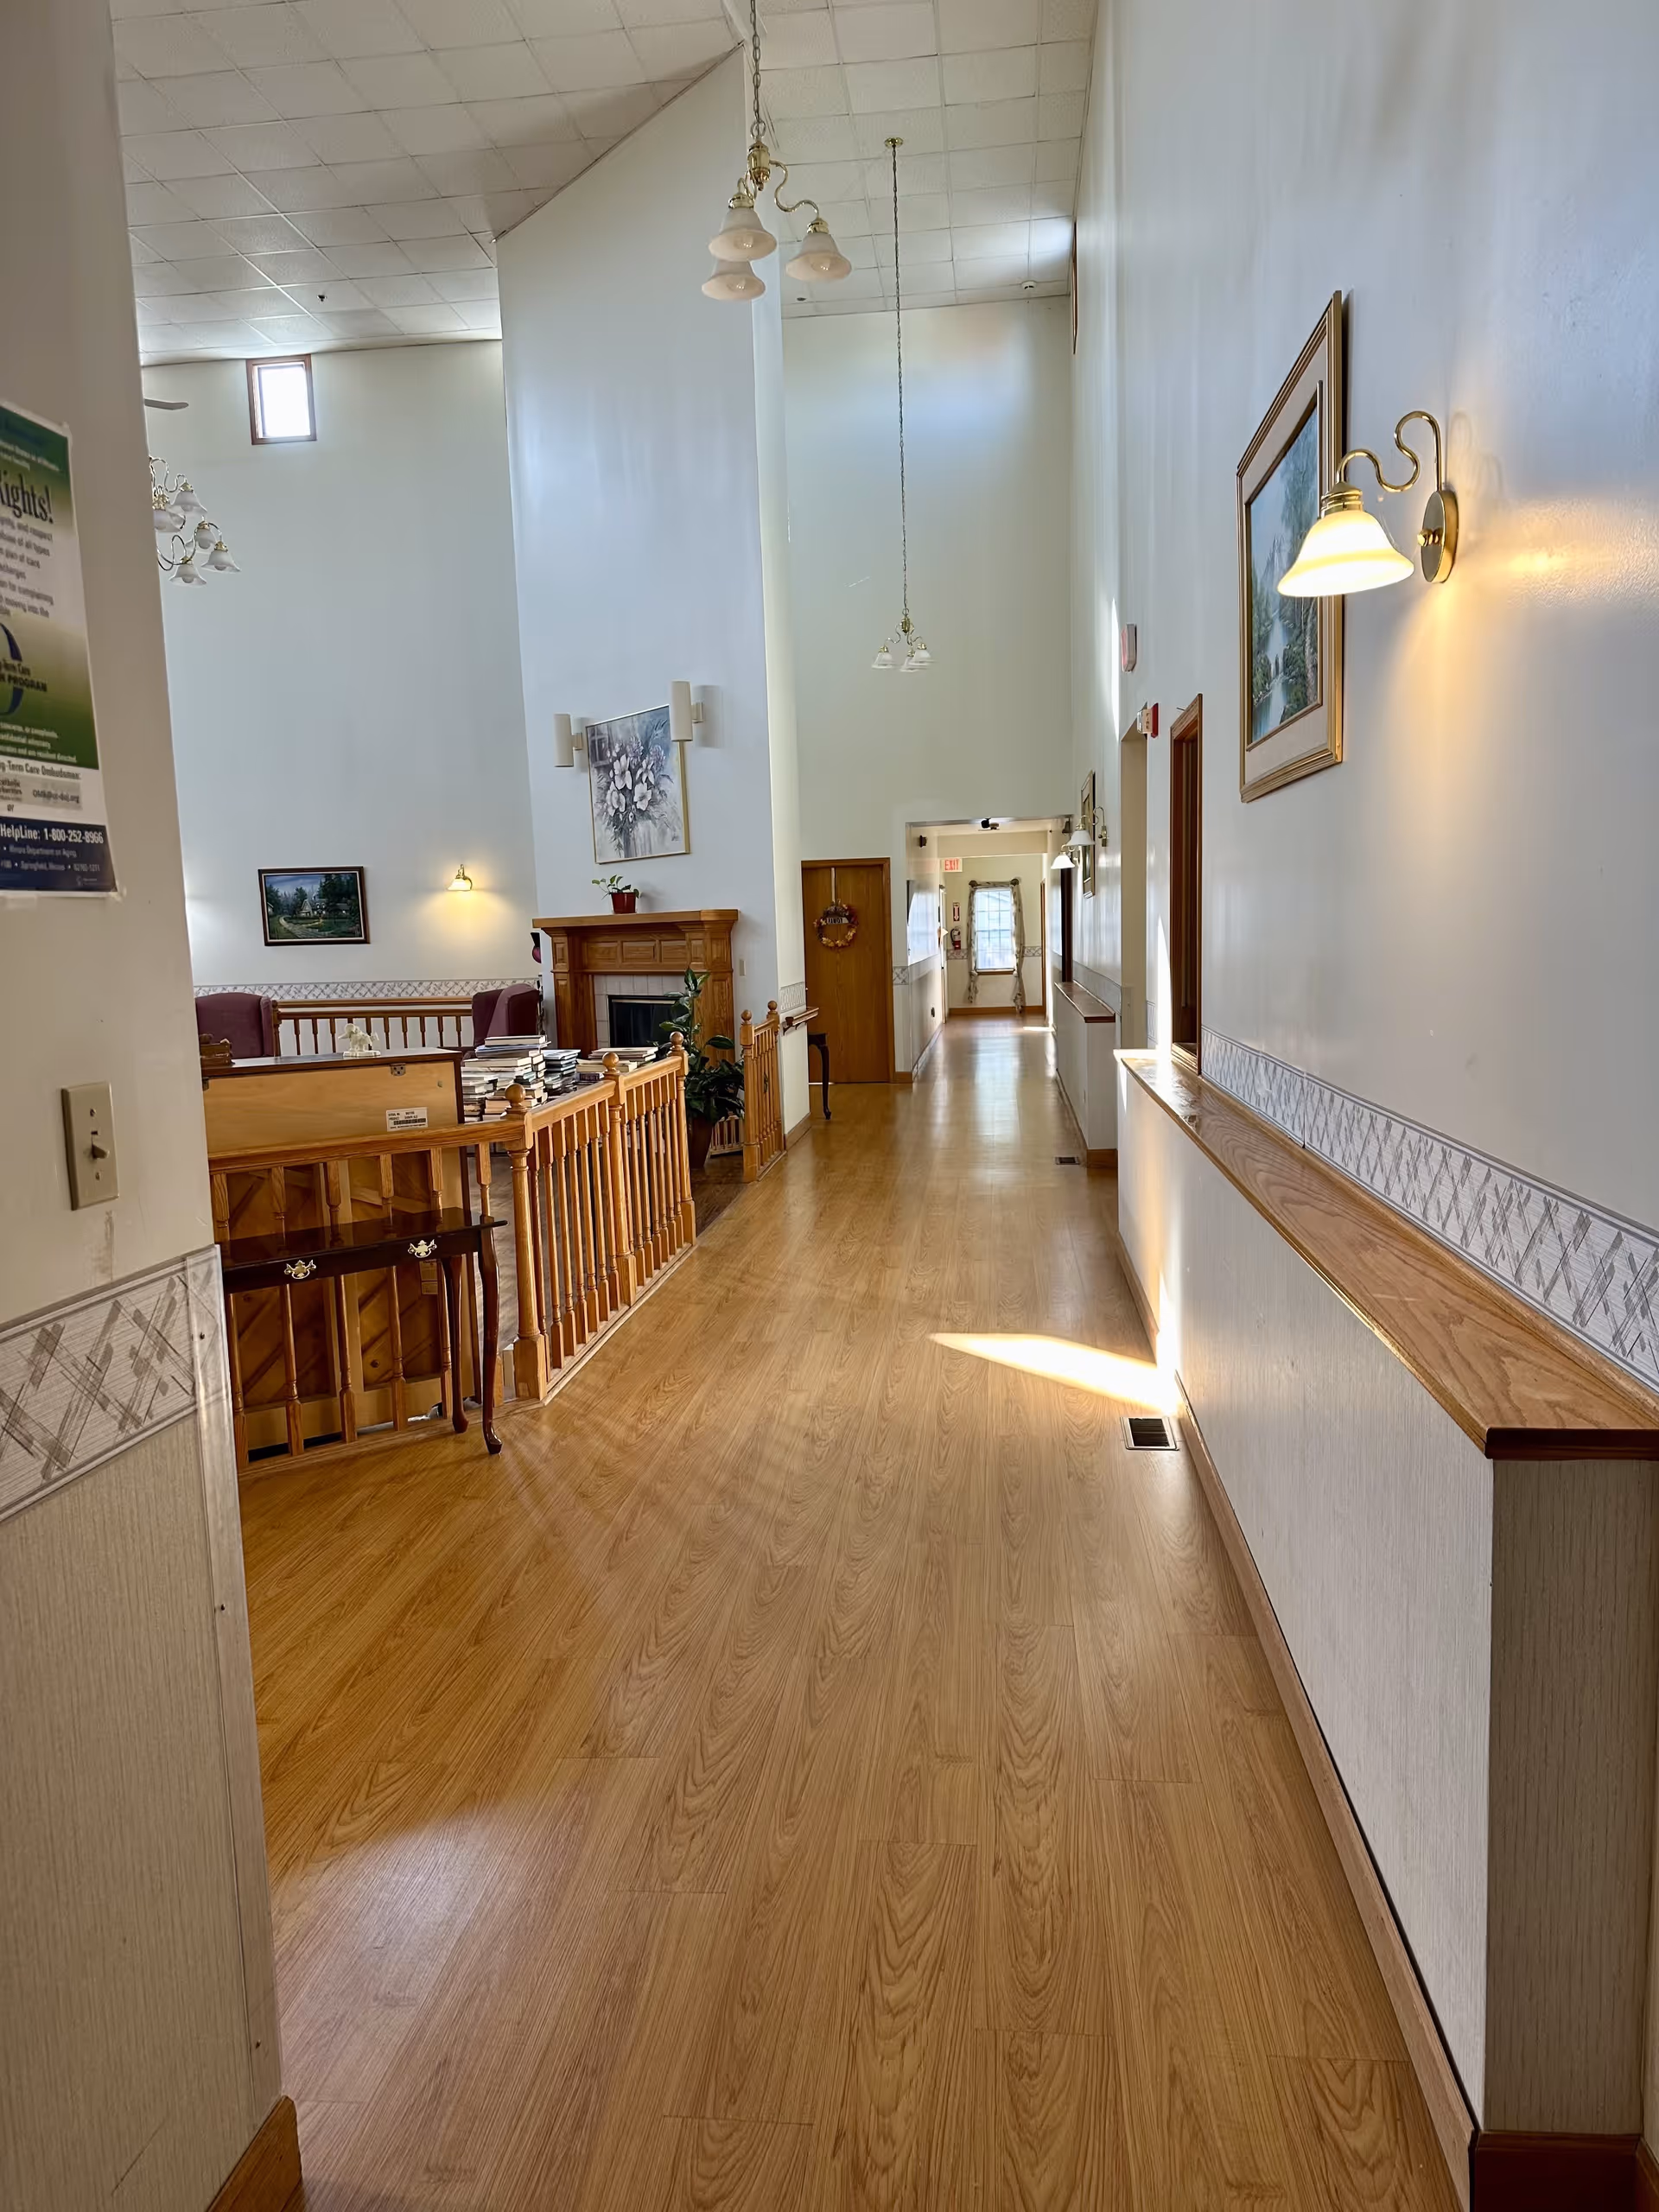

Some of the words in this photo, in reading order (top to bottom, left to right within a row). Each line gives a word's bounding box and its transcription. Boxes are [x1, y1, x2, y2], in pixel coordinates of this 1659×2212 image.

[8, 674, 48, 692] PROGRAM
[24, 762, 41, 774] Care
[0, 823, 41, 842] HelpLine:
[43, 827, 104, 845] 1-800-252-8966
[944, 859, 959, 871] EXIT
